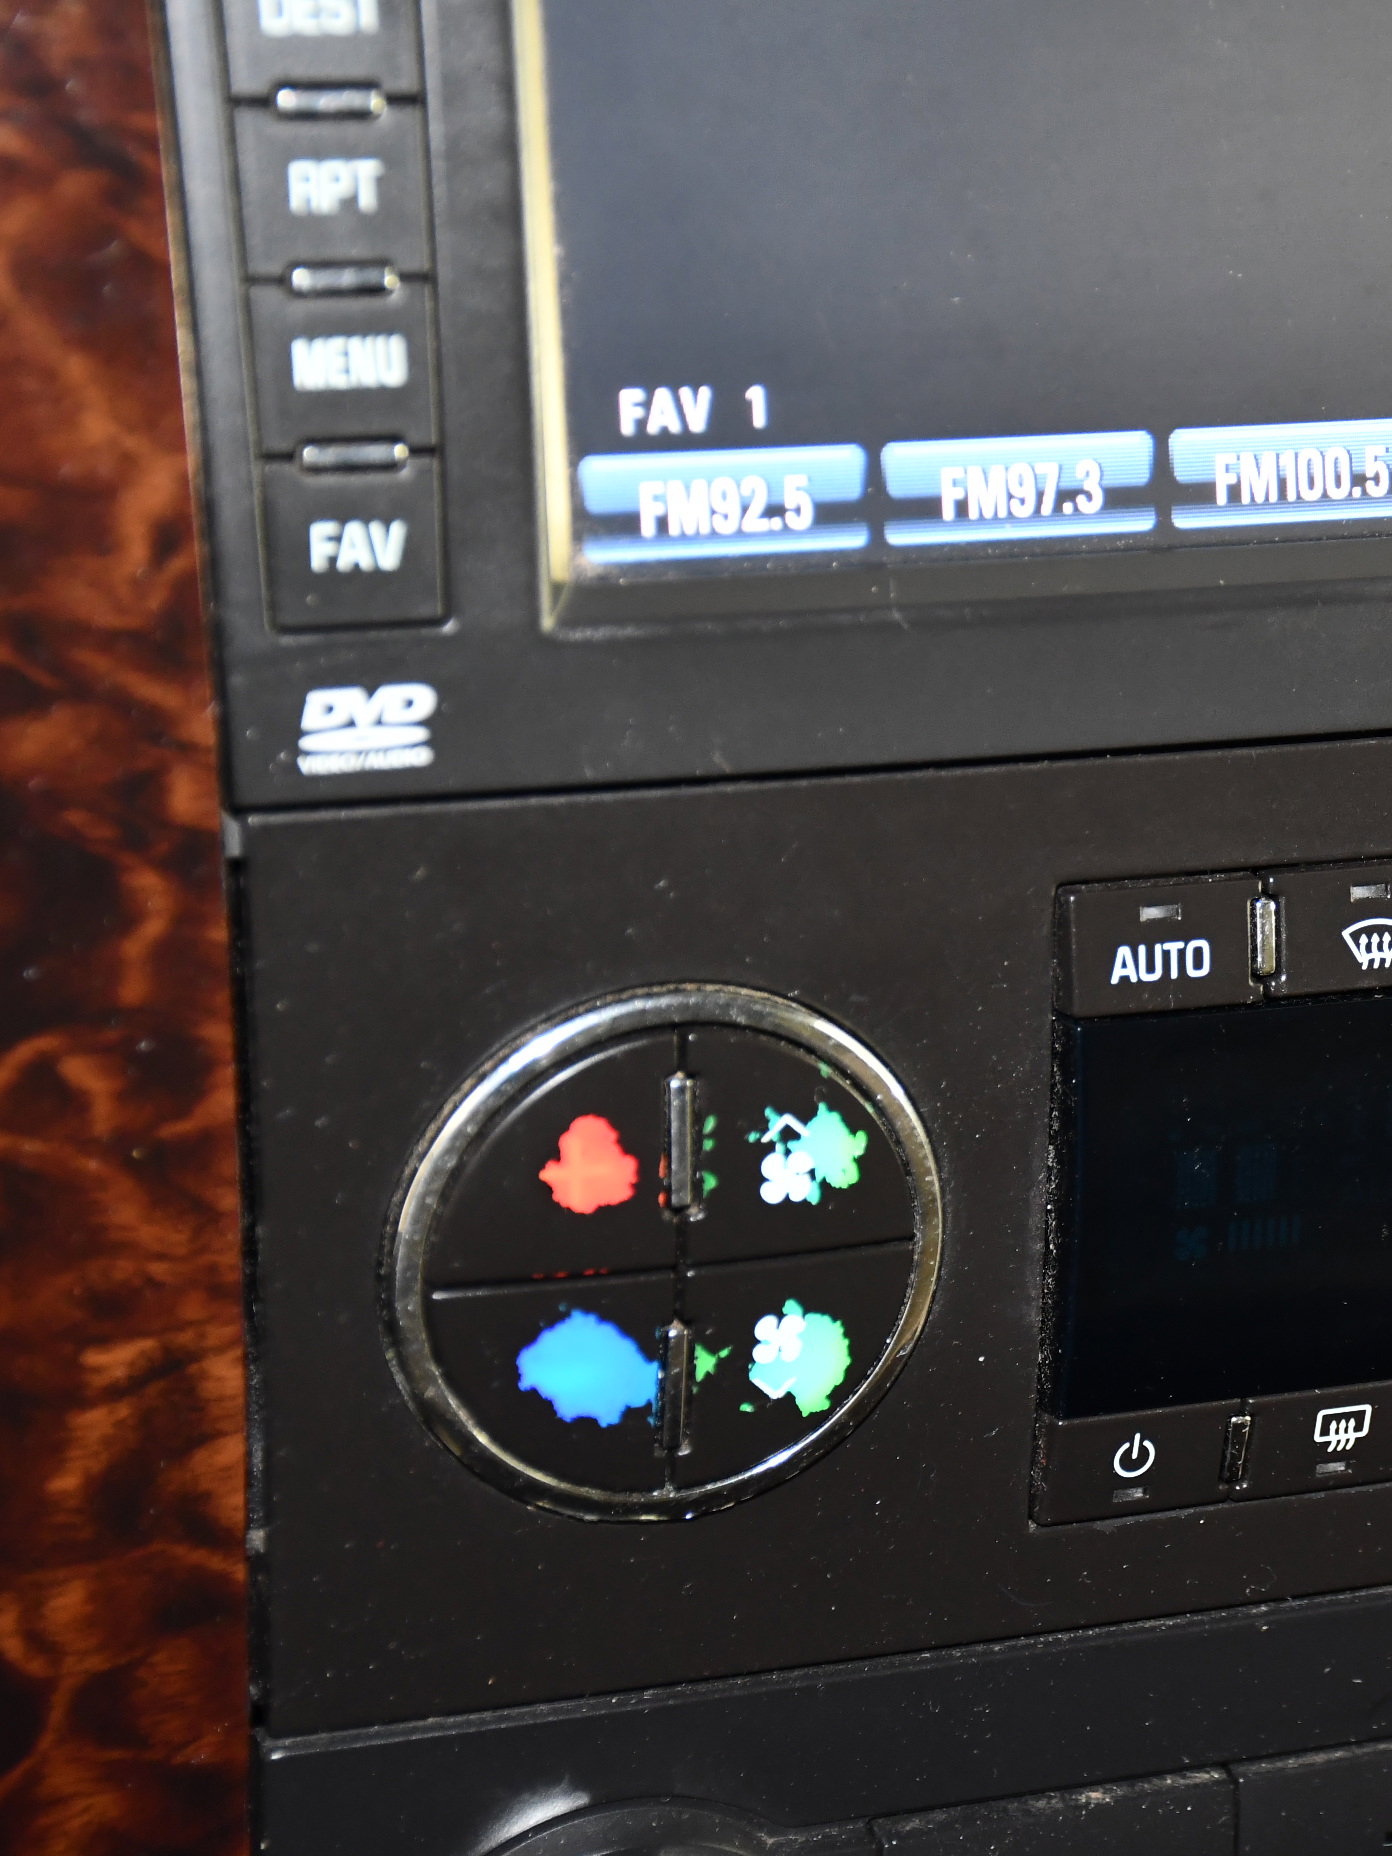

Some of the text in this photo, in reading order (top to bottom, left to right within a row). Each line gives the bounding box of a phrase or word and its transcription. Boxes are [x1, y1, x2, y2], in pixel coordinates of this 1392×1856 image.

[287, 158, 384, 215] RPT
[290, 334, 409, 391] MENU
[617, 384, 768, 437] FAV 1
[939, 459, 1104, 521] FM97.3
[1214, 446, 1389, 506] FM100.5
[638, 474, 814, 538] FM92.5
[309, 520, 408, 573] FAV
[300, 682, 438, 733] DVD
[1110, 938, 1212, 985] AUTO
